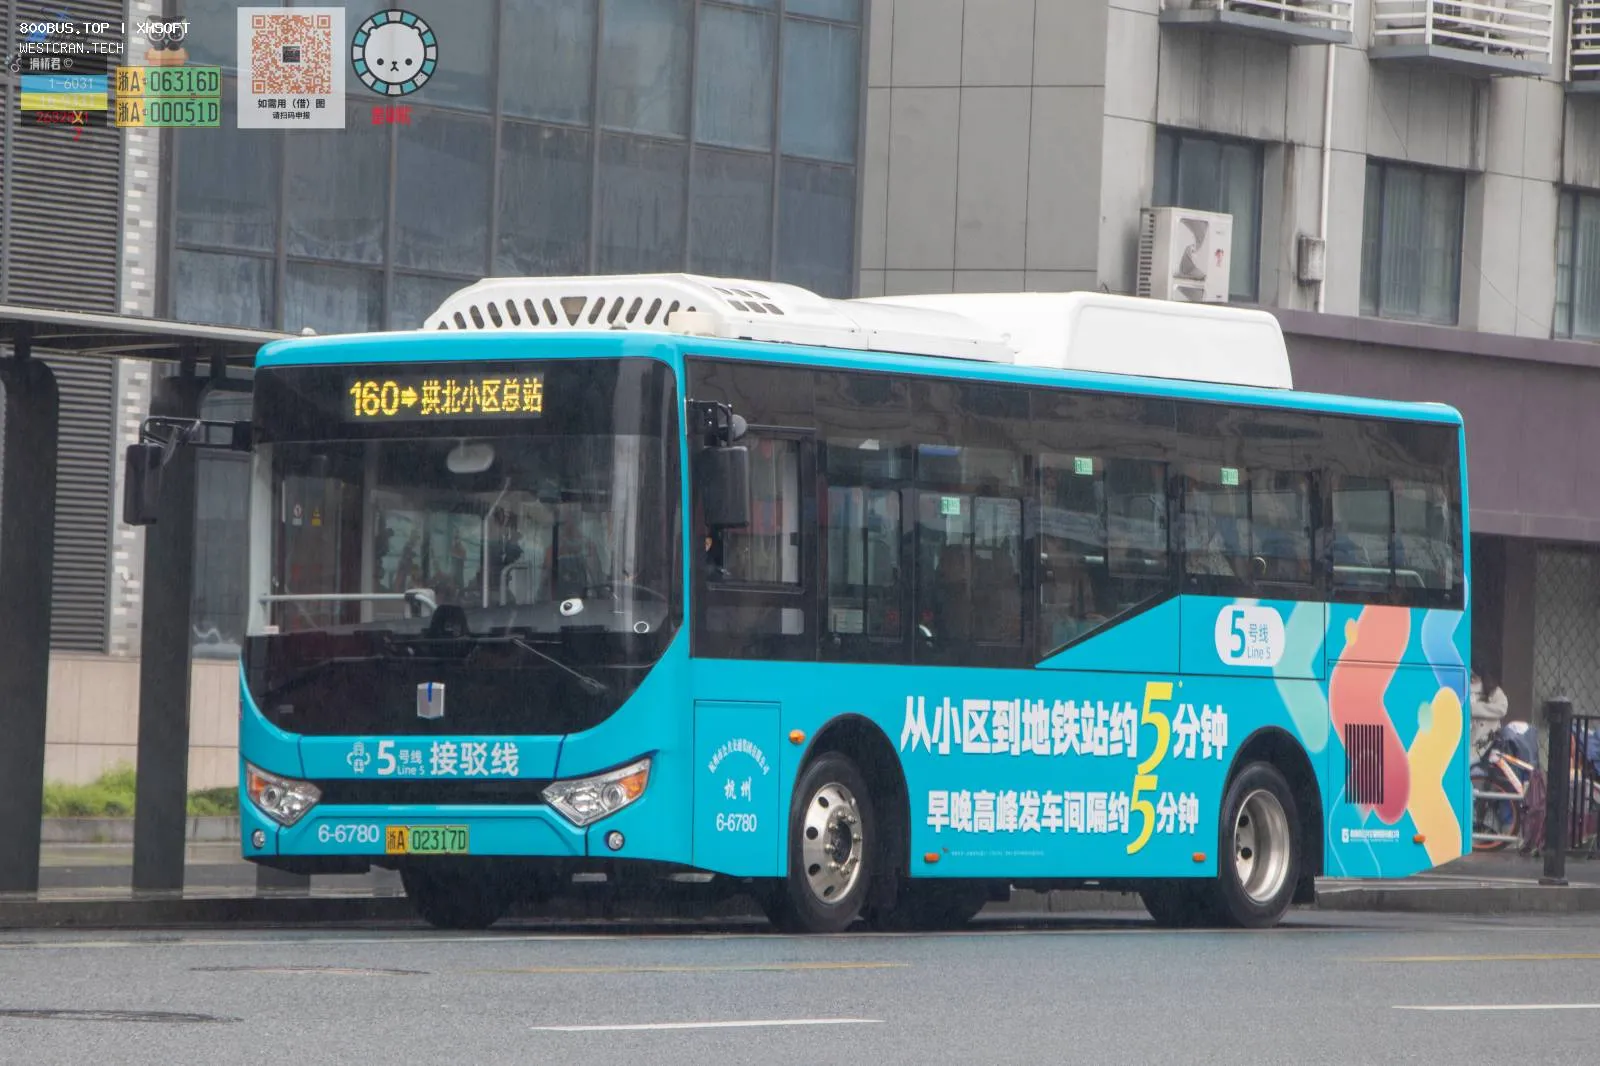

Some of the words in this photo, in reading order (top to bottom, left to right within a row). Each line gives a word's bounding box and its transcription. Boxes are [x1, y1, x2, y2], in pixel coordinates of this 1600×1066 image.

[349, 380, 399, 416] 160
[420, 377, 543, 415] 拱北小区总站
[430, 741, 519, 776] 接驳线
[318, 824, 379, 842] 6-6780
[716, 812, 757, 832] 6-6780
